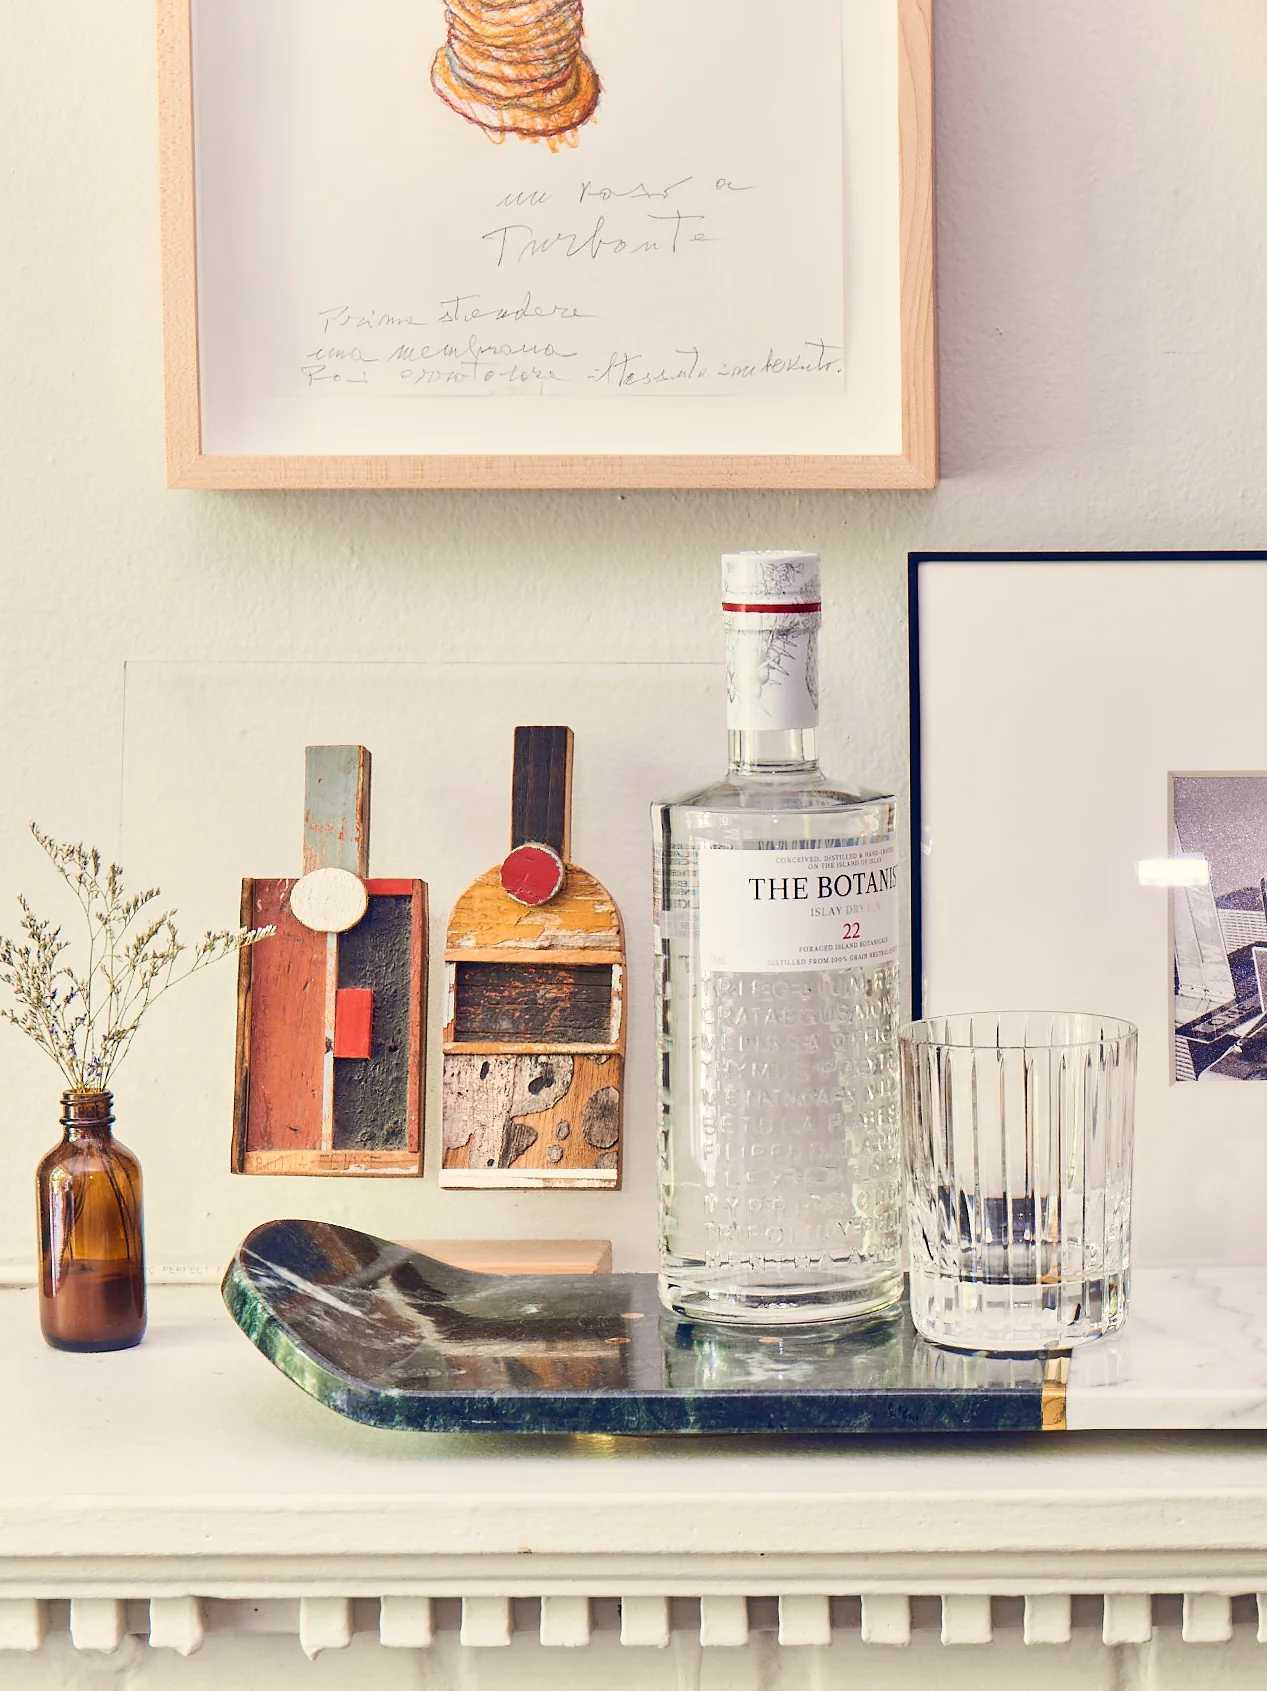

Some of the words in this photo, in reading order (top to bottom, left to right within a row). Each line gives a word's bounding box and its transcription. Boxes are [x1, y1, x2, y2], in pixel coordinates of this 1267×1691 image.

[824, 852, 857, 862] DISTILLED
[807, 862, 819, 870] ON
[821, 861, 834, 869] THE
[836, 858, 859, 868] ISLAND
[748, 877, 809, 900] THE
[817, 864, 898, 899] BOTANIS
[810, 906, 843, 917] ISLAY
[846, 904, 865, 915] DRY
[842, 922, 861, 940] 22
[799, 944, 833, 953] FORAGED
[835, 942, 859, 951] ISLAND
[767, 958, 806, 967] DISTILLED
[808, 957, 829, 965] FROM
[831, 956, 848, 964] 100%
[849, 953, 868, 961] GRAIN
